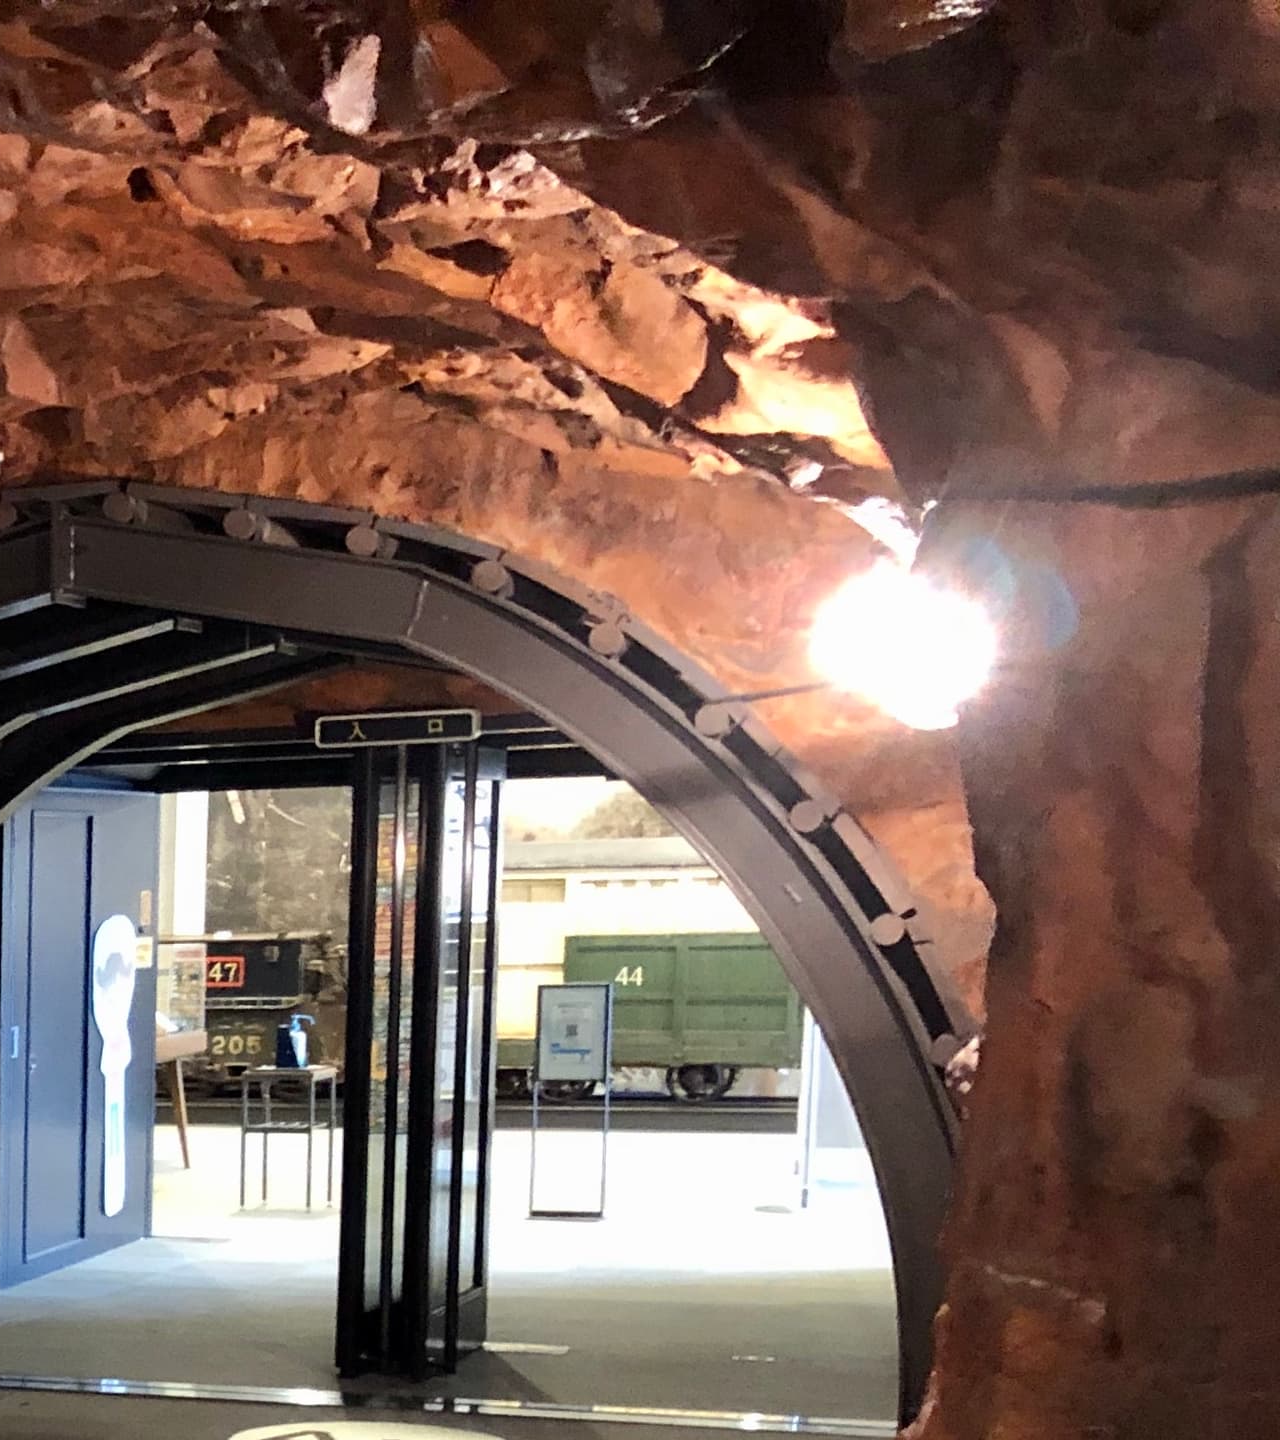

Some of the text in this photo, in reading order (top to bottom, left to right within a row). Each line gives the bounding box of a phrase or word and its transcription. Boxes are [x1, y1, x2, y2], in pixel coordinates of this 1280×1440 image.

[348, 719, 444, 740] 入口
[614, 966, 643, 986] 44
[212, 1035, 263, 1055] 205
